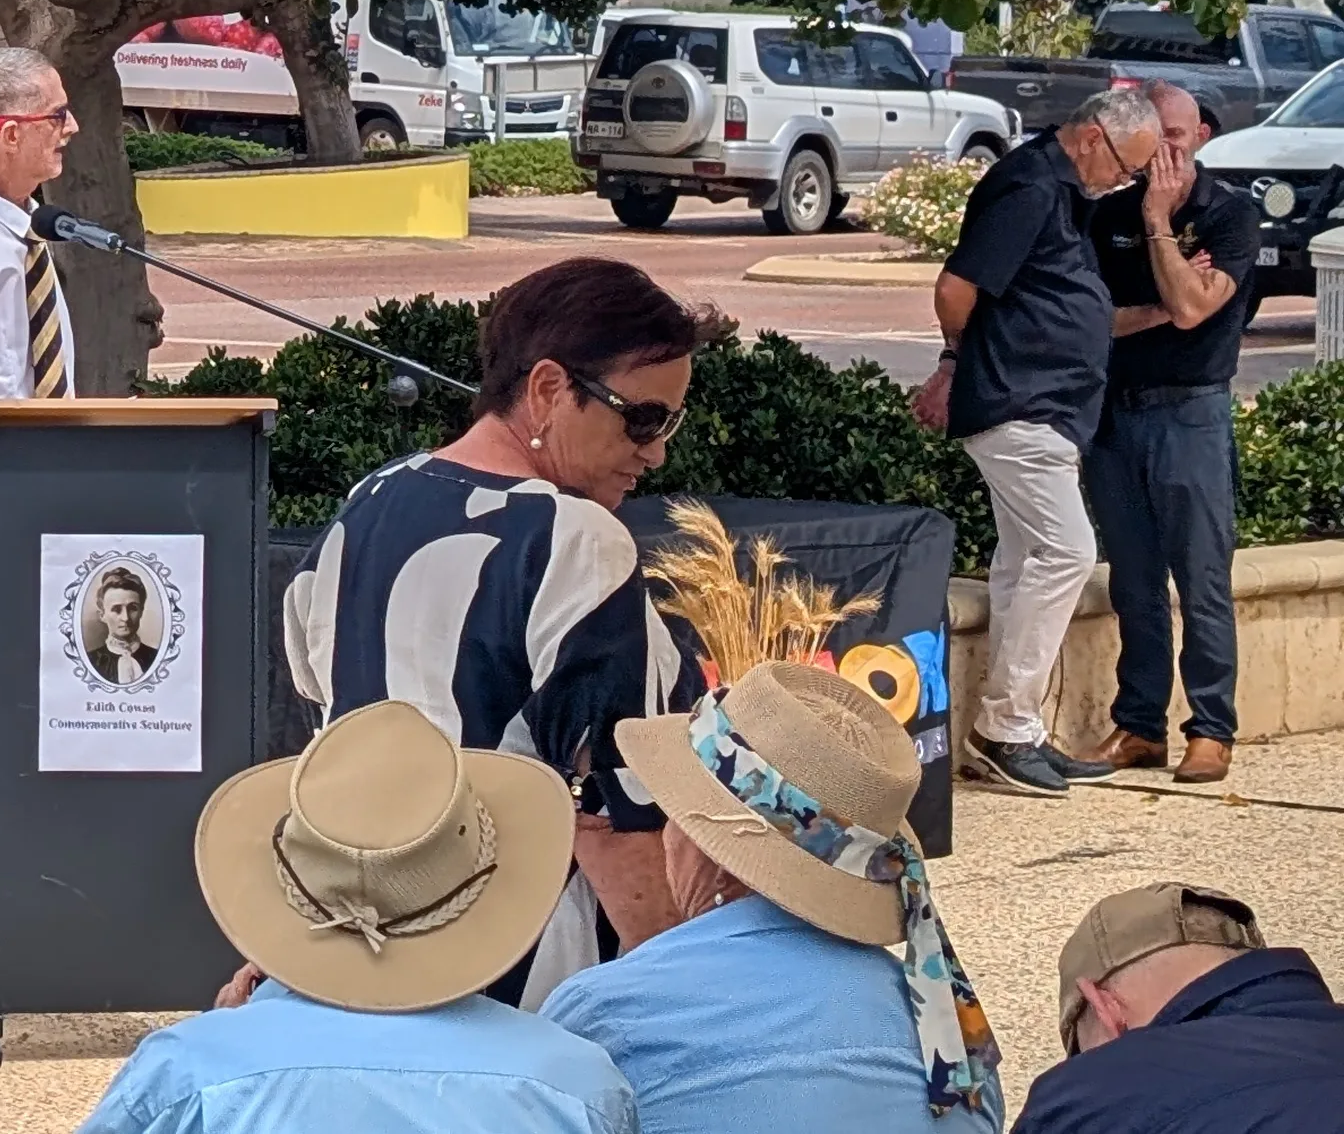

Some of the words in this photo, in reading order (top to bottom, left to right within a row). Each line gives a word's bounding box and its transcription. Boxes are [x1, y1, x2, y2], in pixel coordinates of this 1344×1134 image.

[117, 52, 168, 68] Delivering
[170, 53, 218, 68] freshness
[220, 56, 248, 72] daily
[418, 93, 443, 107] Zeke
[86, 701, 115, 713] Edith
[118, 702, 156, 714] Cowan
[48, 718, 137, 730] Commemorative
[139, 719, 193, 733] Sculpture
